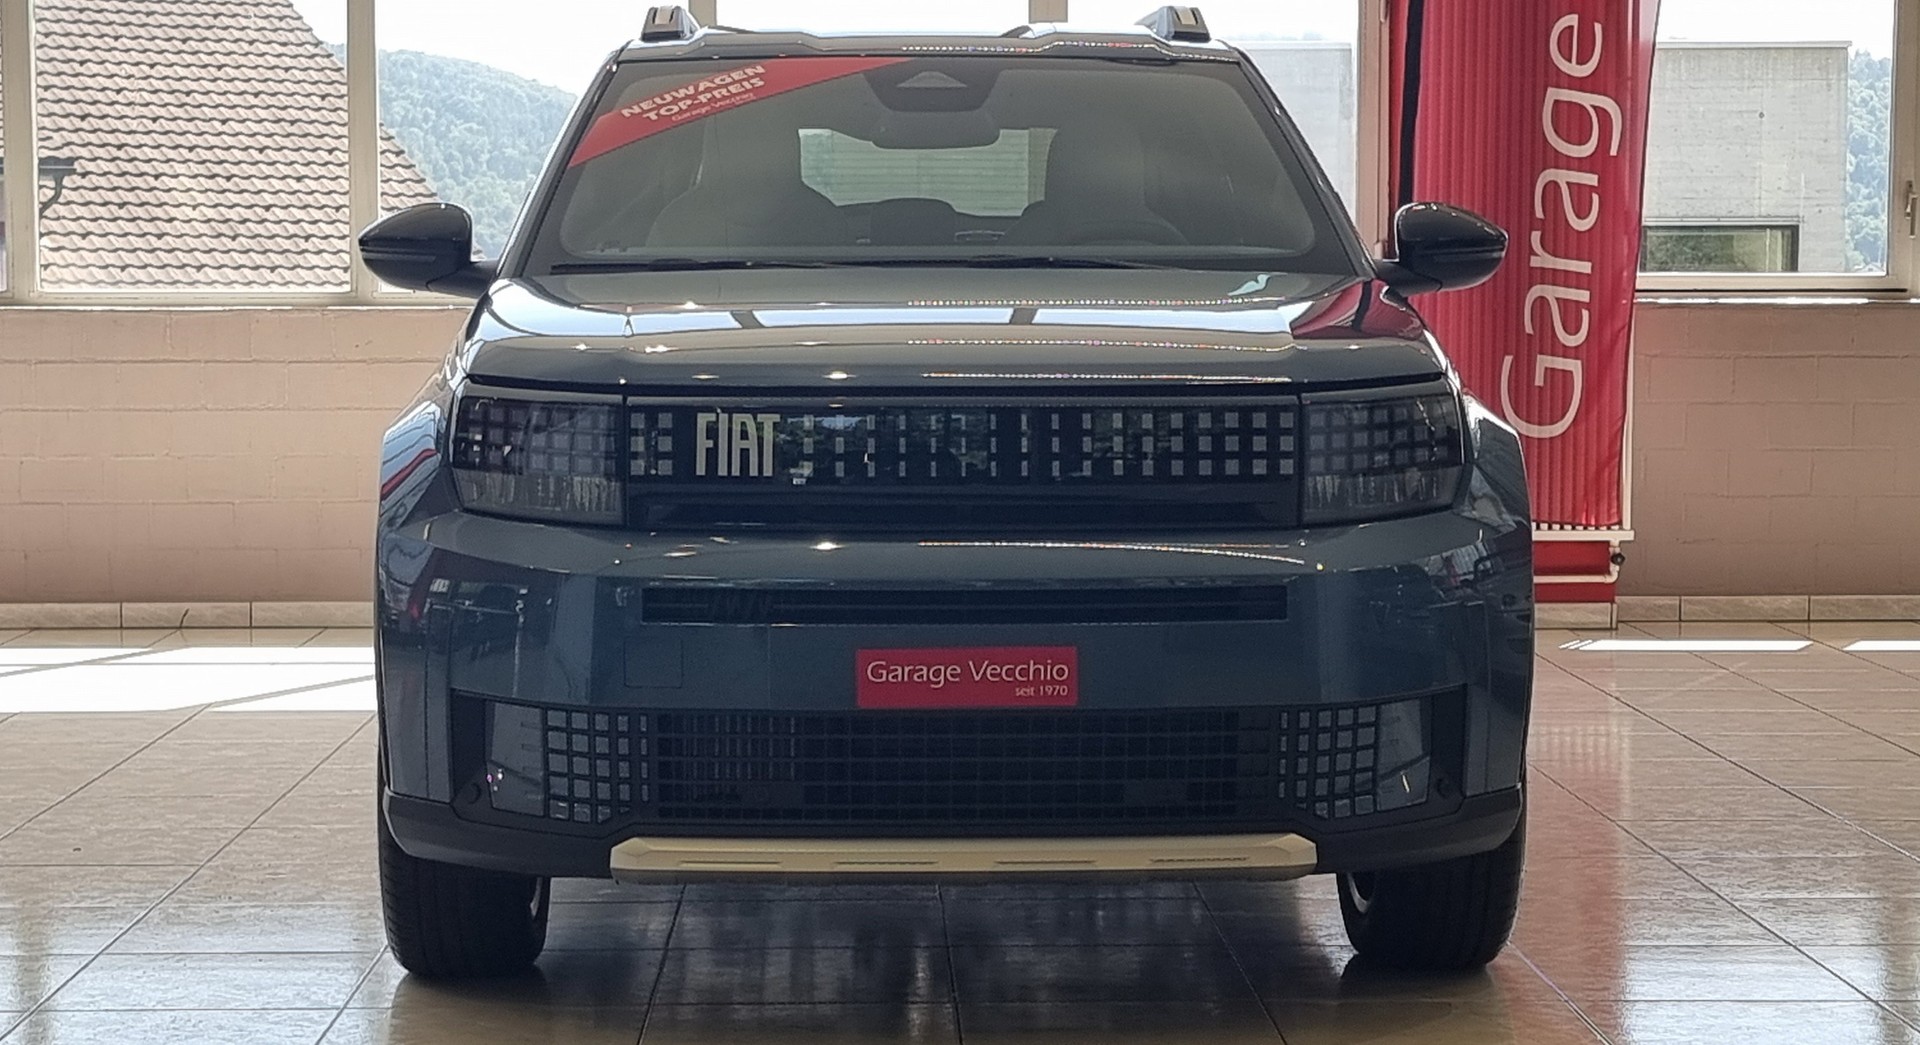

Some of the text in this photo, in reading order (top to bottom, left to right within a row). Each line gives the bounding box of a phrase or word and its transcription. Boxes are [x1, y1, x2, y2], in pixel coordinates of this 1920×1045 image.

[620, 65, 766, 118] NEUWAGEN
[642, 77, 765, 121] TOP-PREIS
[1500, 13, 1623, 438] Garage
[695, 412, 781, 477] FIAT
[866, 659, 1069, 688] Garage Vecchio
[1015, 685, 1068, 697] seit 1970
